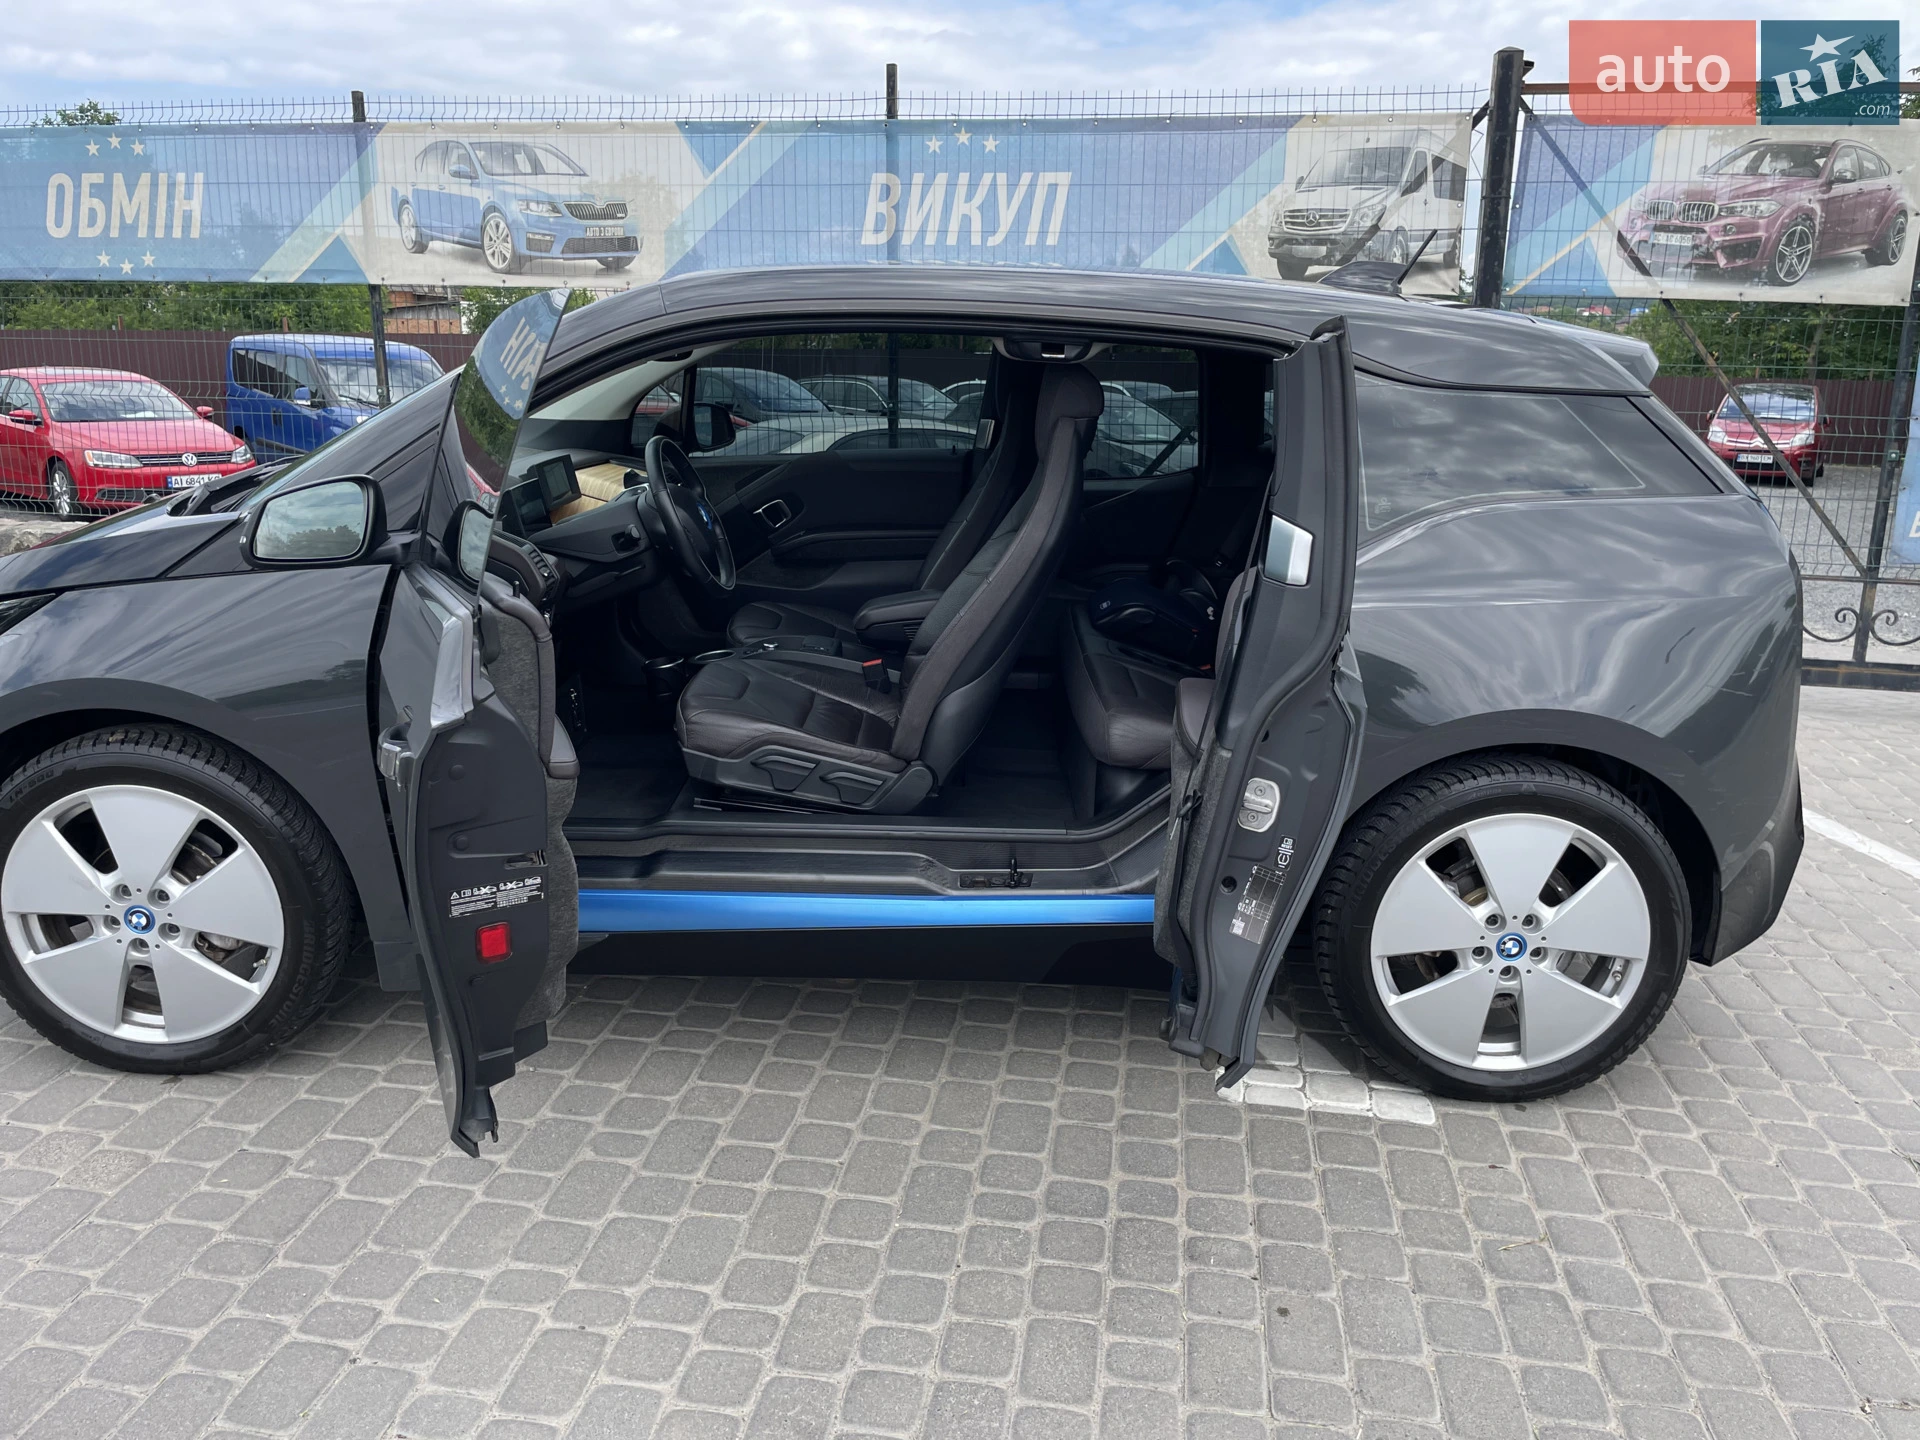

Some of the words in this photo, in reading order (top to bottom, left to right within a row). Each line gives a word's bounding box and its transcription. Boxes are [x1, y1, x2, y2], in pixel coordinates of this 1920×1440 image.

[46, 172, 204, 239] ОБМІН
[861, 171, 1073, 247] ВИКУП
[173, 477, 183, 486] AI
[185, 475, 205, 486] 6841
